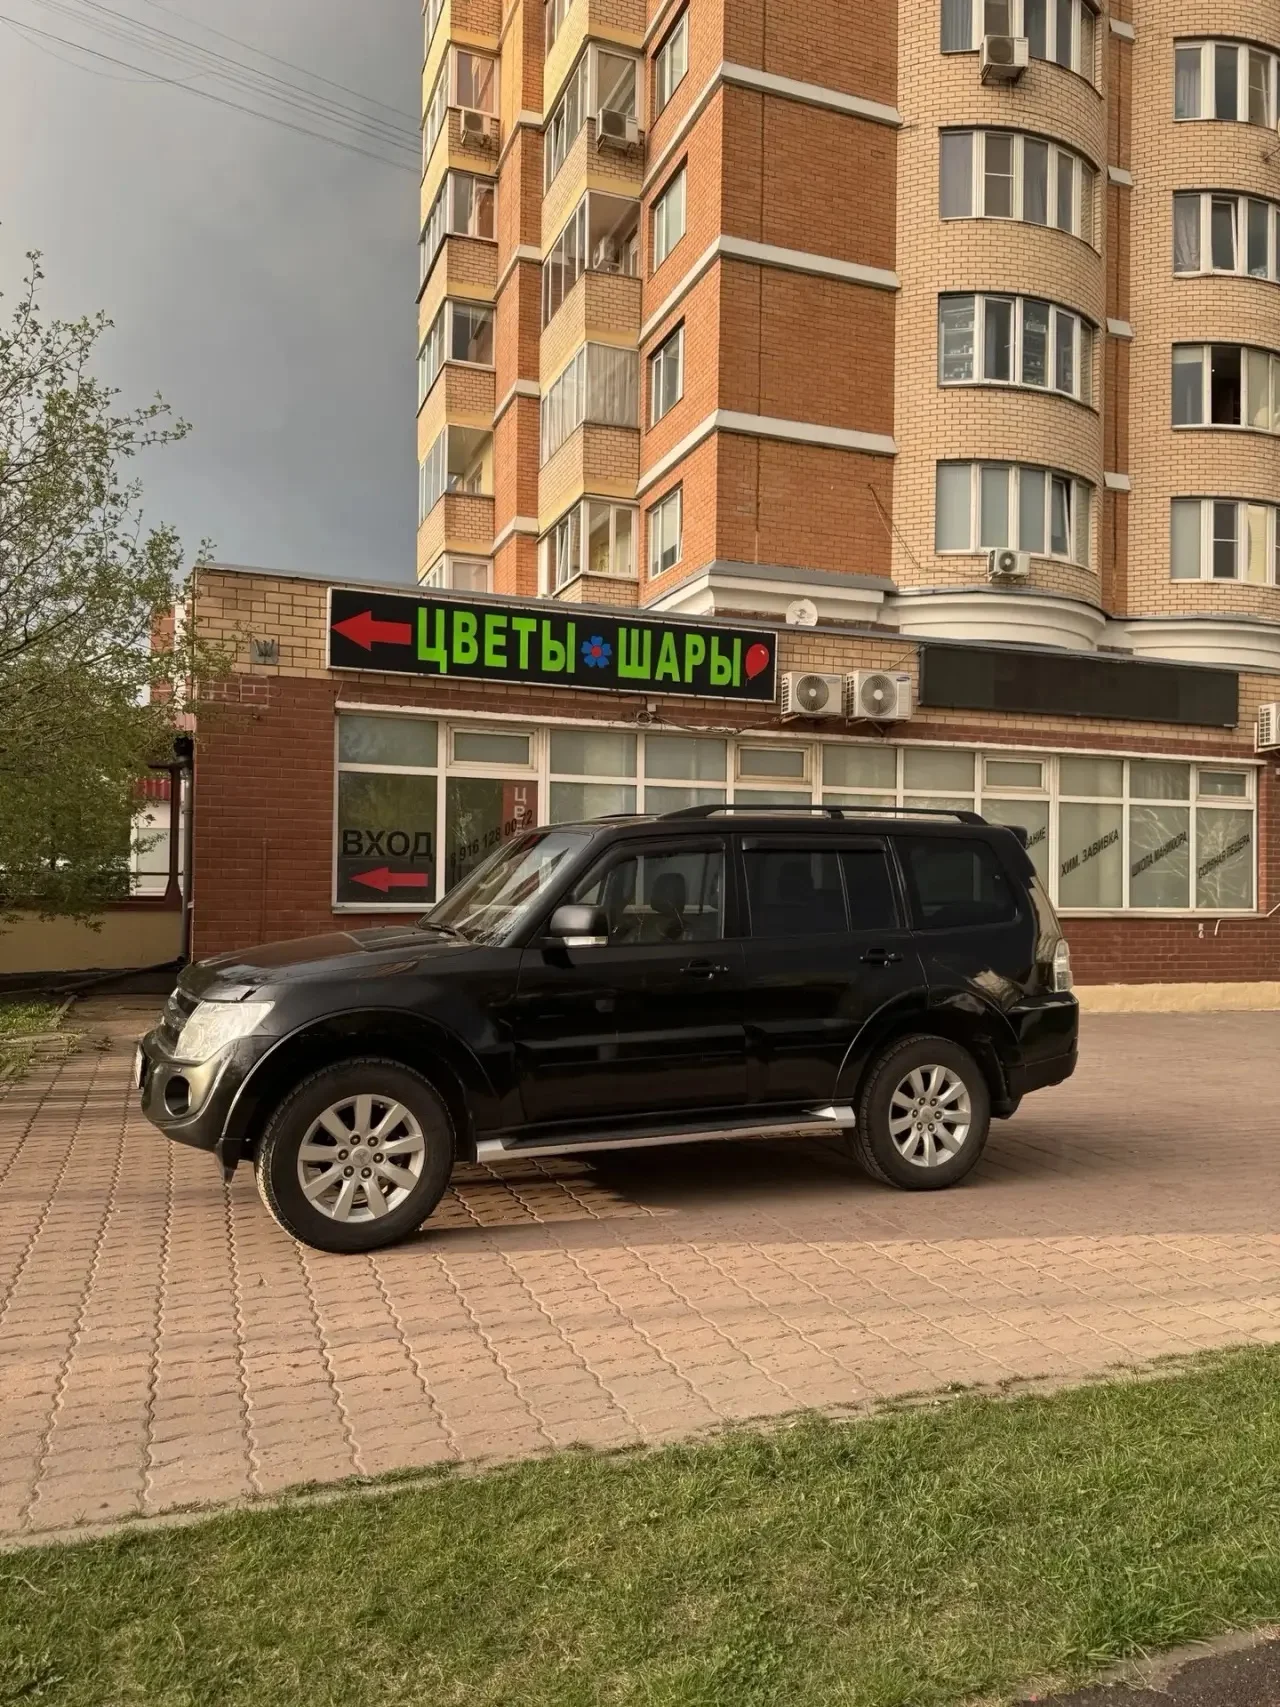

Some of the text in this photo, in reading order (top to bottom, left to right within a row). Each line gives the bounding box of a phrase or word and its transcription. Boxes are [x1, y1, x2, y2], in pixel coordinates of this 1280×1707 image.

[416, 606, 742, 687] ЦВЕТЫ ШАРЫ
[342, 829, 433, 863] ВХОД
[459, 838, 480, 861] 916
[1081, 828, 1119, 863] ЗАВИВКА
